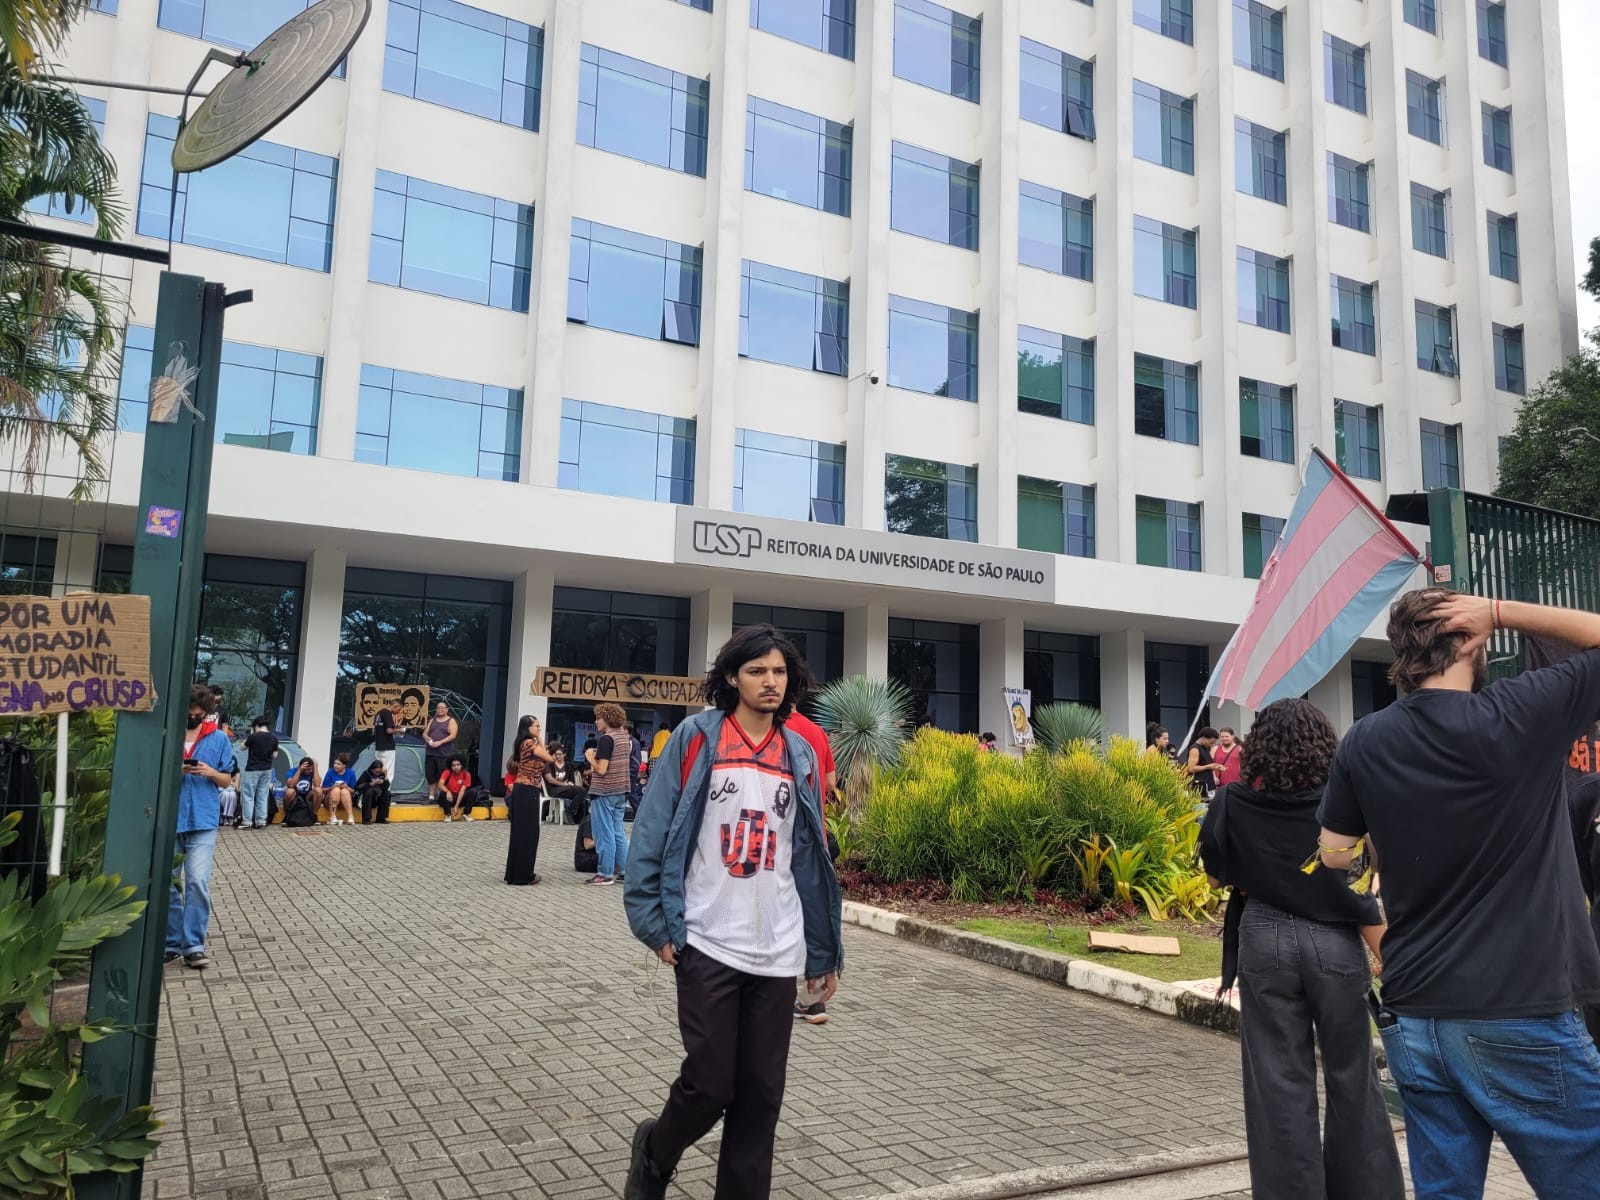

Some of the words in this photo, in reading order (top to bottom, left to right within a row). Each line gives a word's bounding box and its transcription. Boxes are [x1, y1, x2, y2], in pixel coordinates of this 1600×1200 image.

[693, 521, 762, 558] USP
[767, 538, 832, 559] REITORIA
[836, 547, 856, 562] DA
[859, 549, 955, 574] UNIVERSIDADE
[958, 561, 975, 577] DE
[978, 562, 1003, 580] SÃO
[1006, 567, 1045, 585] PAULO
[0, 601, 51, 629] POR
[61, 599, 116, 626] UMA
[0, 628, 112, 654] MORADIA
[67, 678, 146, 711] CRUSP
[542, 671, 620, 698] REITORIA
